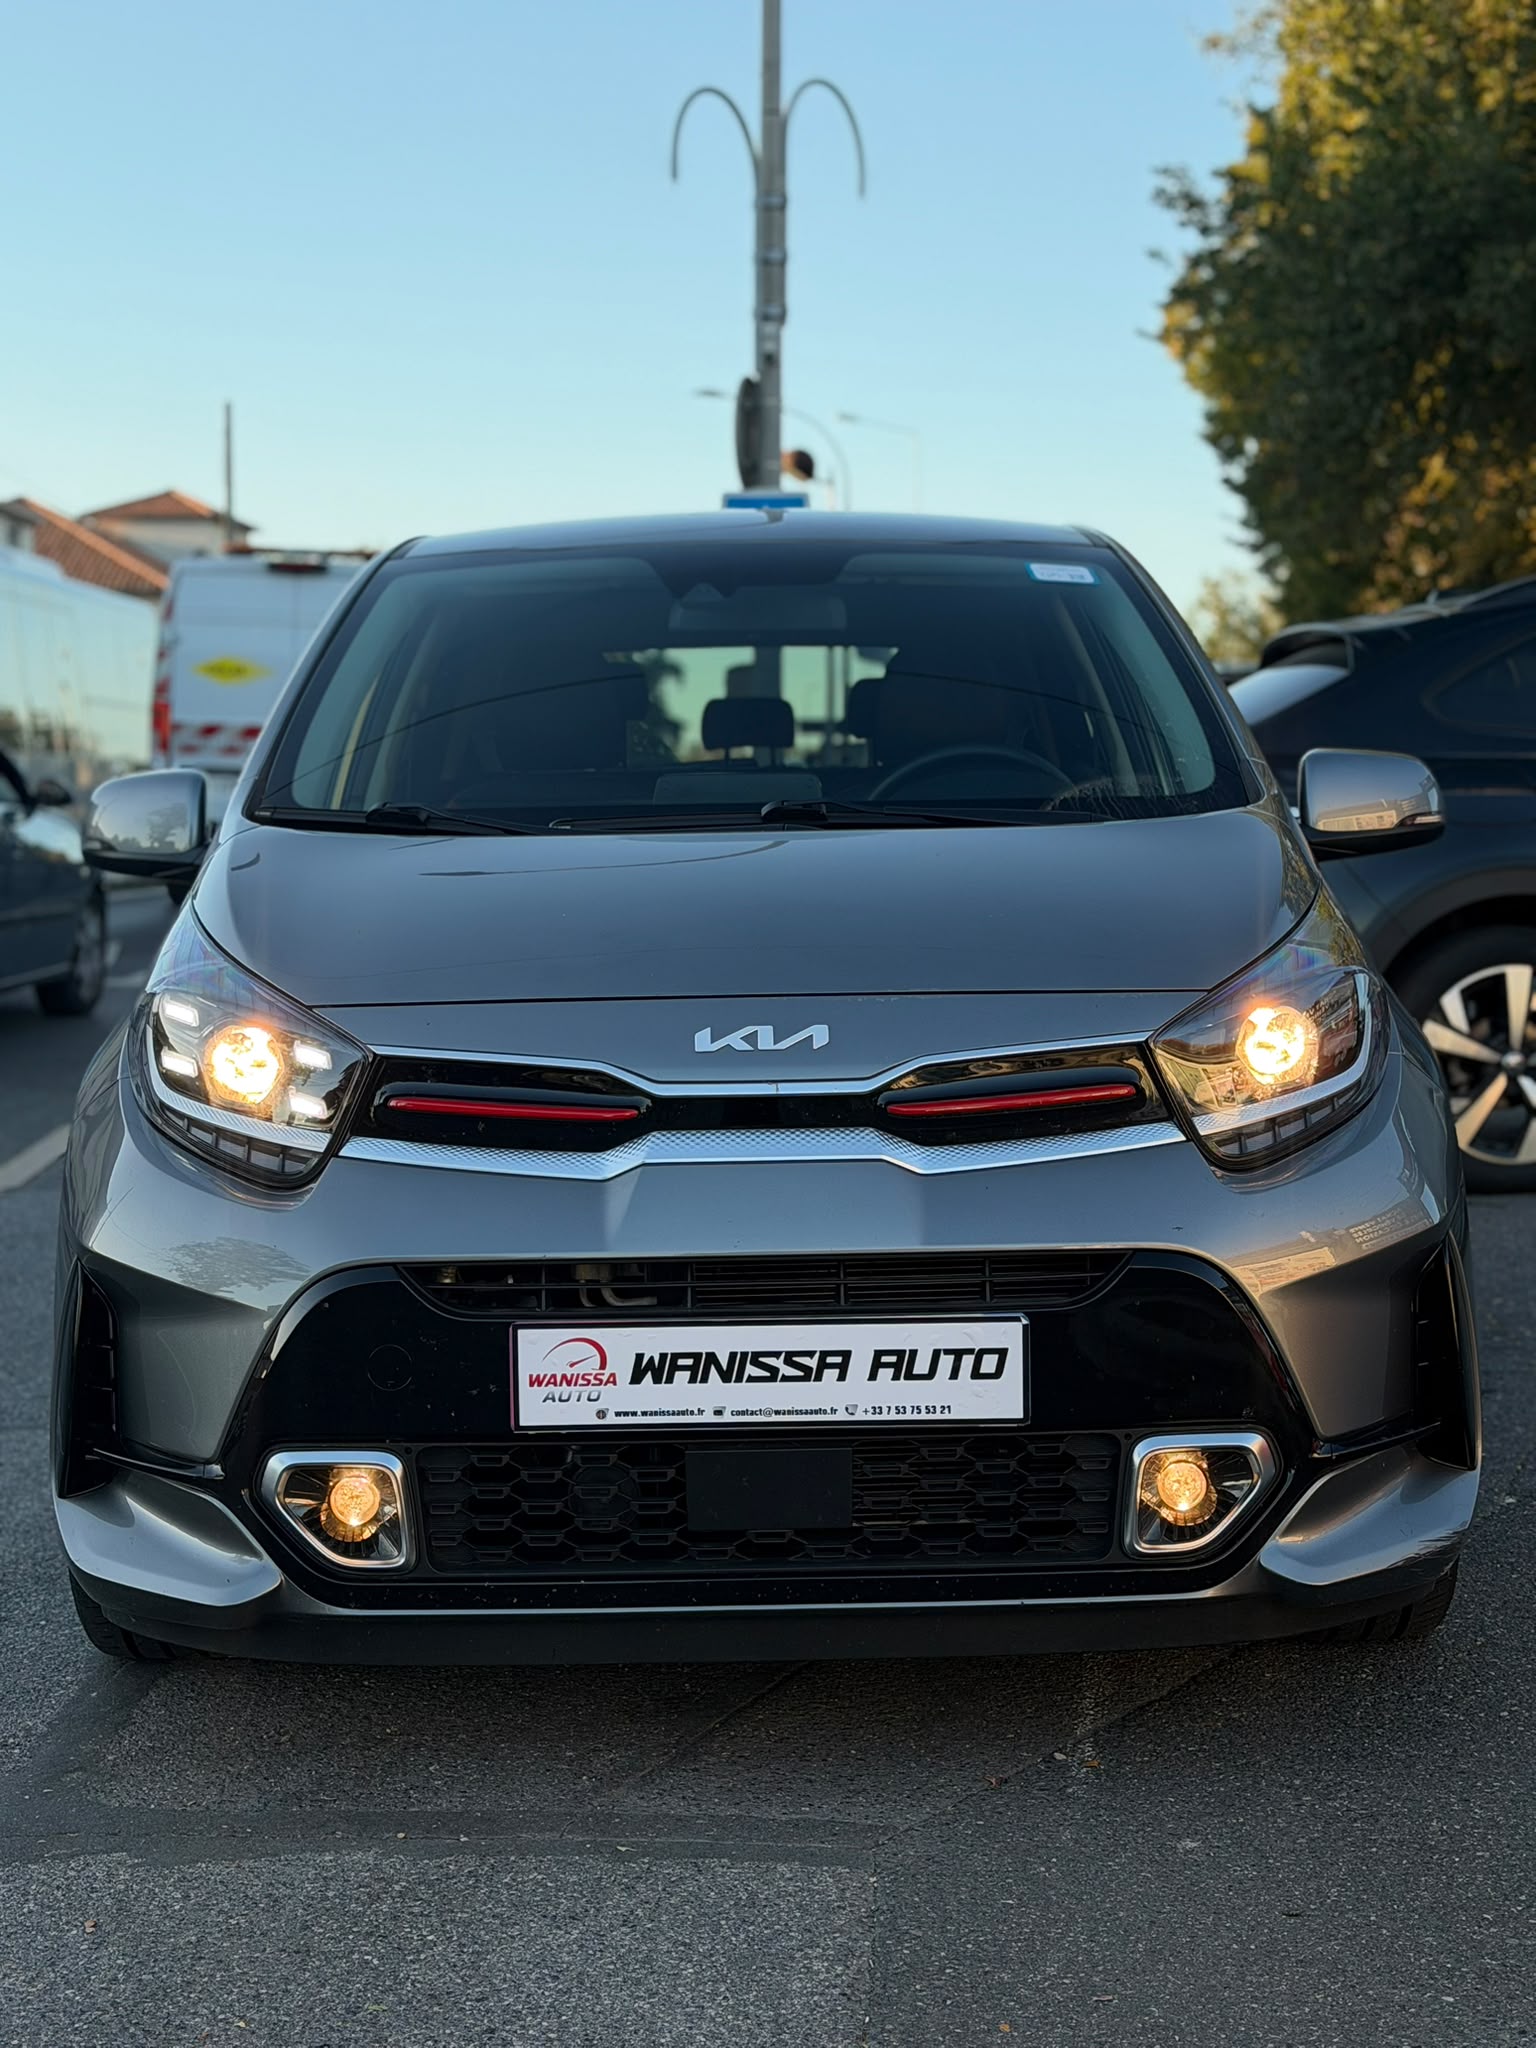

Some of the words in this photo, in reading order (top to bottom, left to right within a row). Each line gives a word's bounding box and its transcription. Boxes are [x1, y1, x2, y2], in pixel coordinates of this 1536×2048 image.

[628, 1350, 852, 1385] WANISSA
[867, 1347, 1009, 1382] AUTO
[528, 1372, 618, 1388] WANISSA
[542, 1390, 602, 1403] AUTO
[614, 1407, 706, 1418] www.wanissaauto.fr
[730, 1407, 839, 1418] contact@wanissaauto.fr
[862, 1405, 883, 1416] +33
[886, 1405, 892, 1416] 7
[894, 1405, 907, 1416] 53
[910, 1405, 922, 1416] 75
[925, 1405, 937, 1416] 53
[939, 1405, 952, 1415] 21
